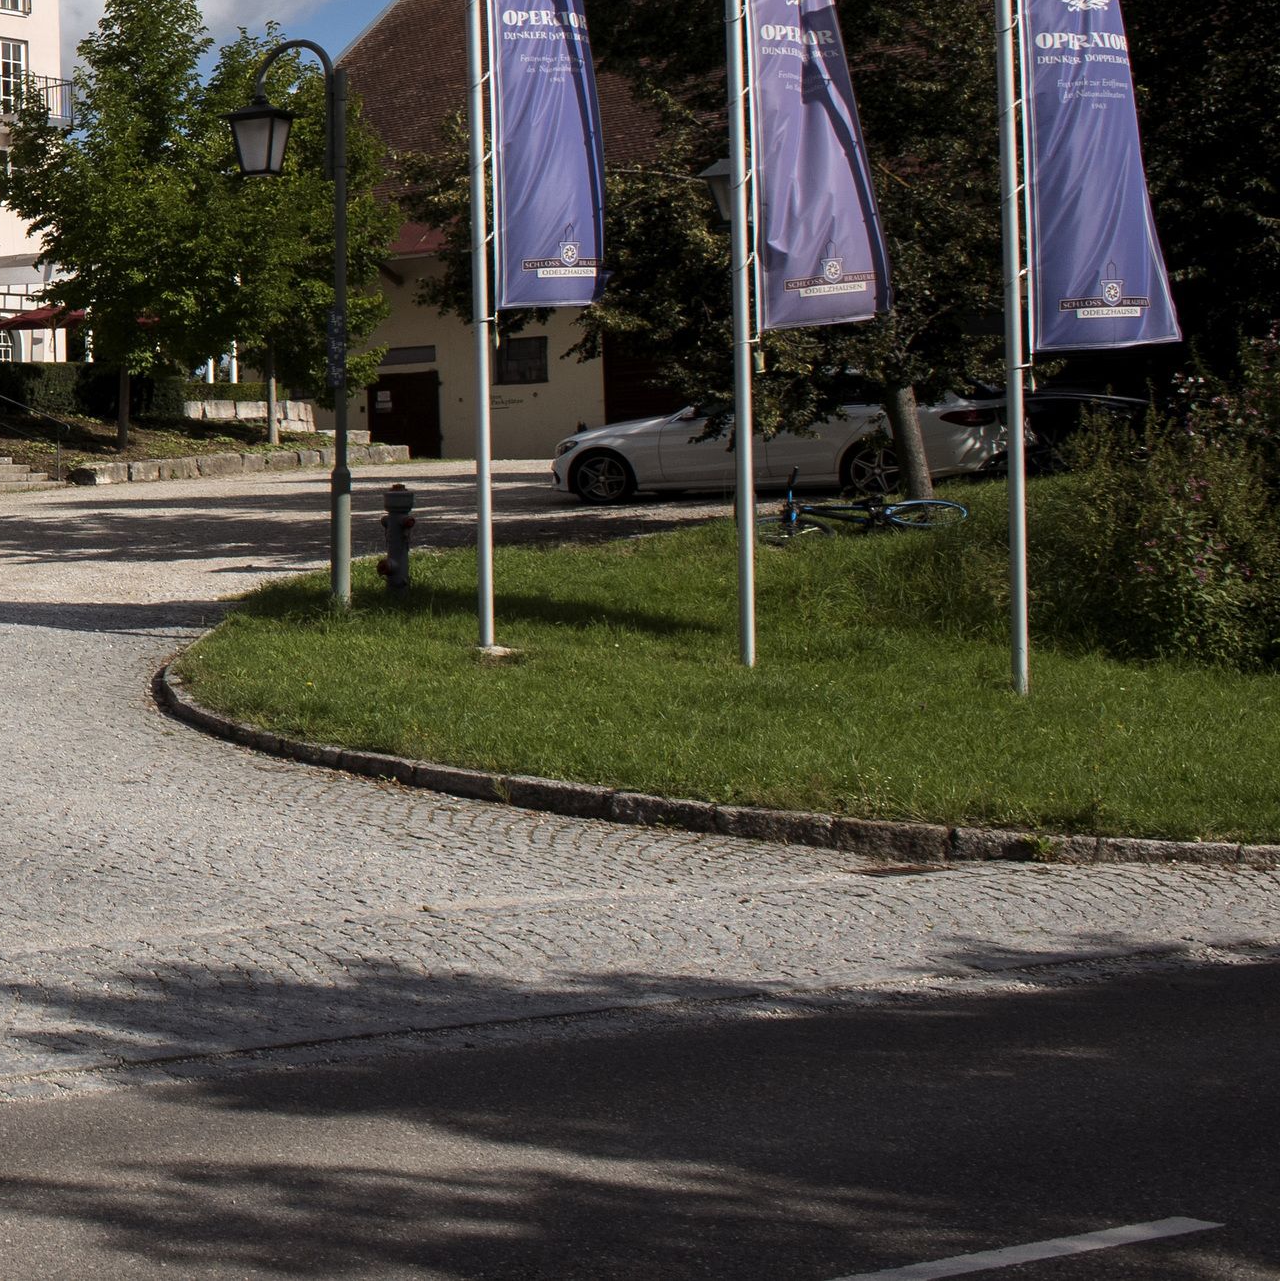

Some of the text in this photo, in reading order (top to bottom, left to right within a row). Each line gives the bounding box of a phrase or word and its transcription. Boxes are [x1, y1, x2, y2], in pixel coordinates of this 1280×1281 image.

[524, 260, 560, 268] SCHLOSS
[787, 278, 824, 289] SCHLOSS
[804, 284, 863, 295] ODELZHAUSEN
[1062, 299, 1102, 309] SCHLOSS
[1082, 308, 1138, 317] ODELZHAUSEN
